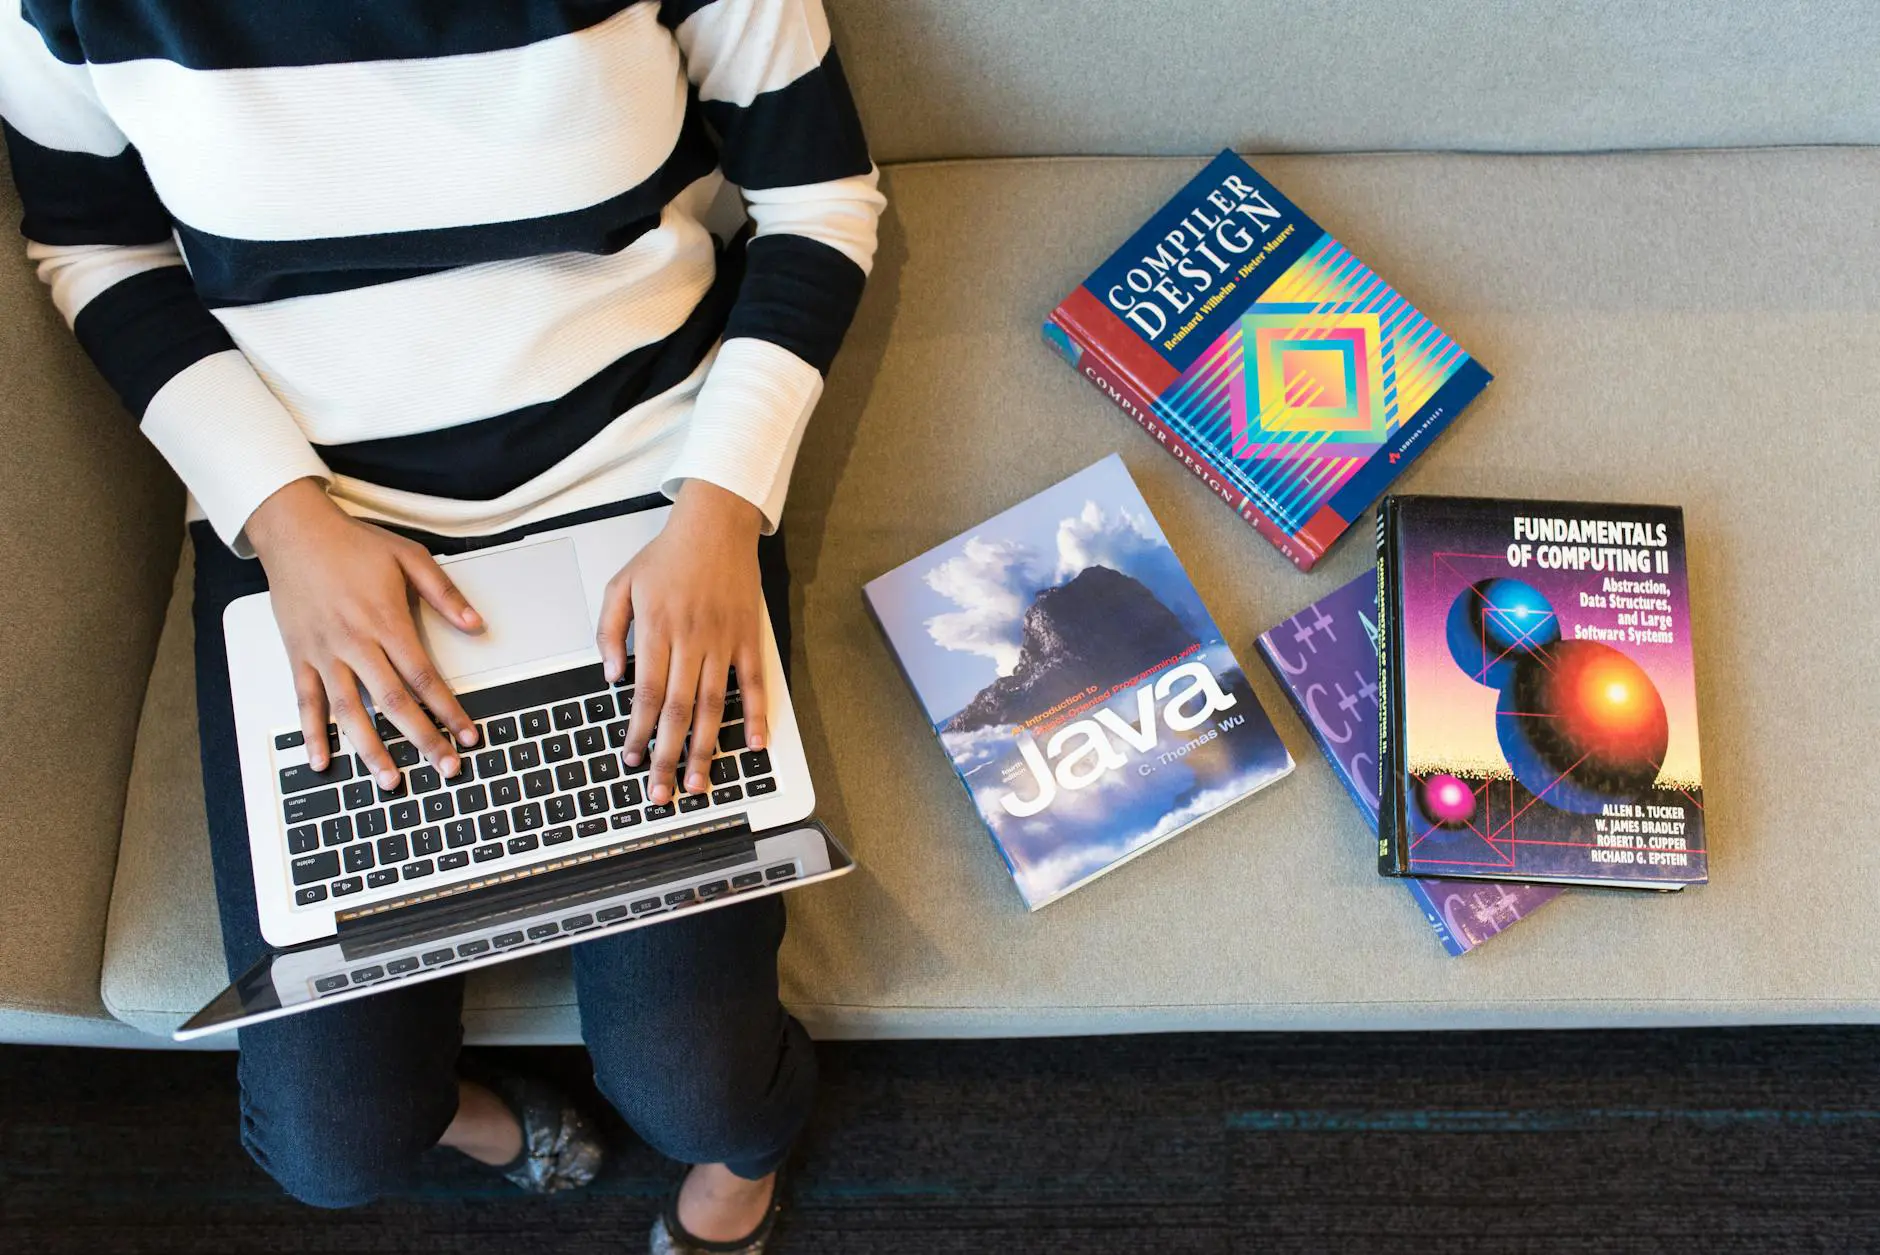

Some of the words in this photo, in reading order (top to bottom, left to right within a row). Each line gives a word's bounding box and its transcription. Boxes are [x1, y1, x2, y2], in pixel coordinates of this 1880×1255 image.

[1109, 175, 1253, 310] COMPILER
[1125, 190, 1281, 340] DESIGN
[1163, 312, 1204, 350] Reinhard
[1200, 281, 1236, 315] Wilhelm
[1239, 252, 1265, 278] Dieter
[1263, 224, 1295, 254] Maurer
[1086, 367, 1167, 443] COMPILER
[1173, 445, 1233, 502] DESIGN
[1514, 517, 1667, 547] FUNDAMENTALS
[1507, 544, 1531, 568] OF
[1537, 545, 1651, 574] COMPUTING
[1656, 551, 1669, 574] II
[1603, 577, 1670, 597] Abstraction,
[1580, 592, 1606, 608] Data
[1609, 593, 1671, 612] Structures,
[1618, 611, 1638, 625] and
[1641, 612, 1672, 630] Large
[1575, 624, 1625, 641] Software
[1628, 627, 1673, 645] Systems
[1382, 651, 1387, 666] OF
[1112, 654, 1179, 693] Programming
[1179, 643, 1201, 658] with
[596, 704, 603, 712] C
[1011, 725, 1026, 736] An
[1026, 692, 1084, 726] Introduction
[1086, 685, 1098, 694] to
[565, 712, 571, 720] V
[532, 719, 538, 727] B
[499, 726, 506, 735] N
[619, 729, 625, 737] D
[587, 737, 592, 745] F
[999, 661, 1237, 817] Java
[553, 744, 560, 752] G
[1138, 763, 1156, 776] C.
[1158, 727, 1217, 765] Thomas
[1218, 714, 1244, 733] Wu
[520, 752, 528, 760] H
[489, 759, 493, 767] J
[569, 772, 574, 780] T
[536, 779, 541, 787] Y
[501, 787, 509, 795] U
[589, 792, 594, 800] 5
[625, 794, 630, 802] $
[434, 802, 442, 810] O
[556, 800, 562, 808] 6
[590, 802, 598, 810] %
[402, 810, 408, 819] P
[524, 808, 529, 816] 7
[1602, 804, 1632, 817] ALLEN
[1635, 805, 1645, 817] B.
[1647, 805, 1684, 819] TUCKER
[490, 816, 495, 824] 8
[1595, 819, 1608, 831] W.
[1610, 820, 1639, 835] JAMES
[1642, 821, 1685, 834] BRADLEY
[422, 832, 428, 840] 0
[1597, 835, 1634, 848] ROBERT
[1636, 837, 1646, 848] D.
[1649, 837, 1686, 850] CUPPER
[297, 858, 315, 866] delete
[1591, 850, 1634, 863] RICHARD
[1636, 852, 1646, 864] G.
[1649, 852, 1687, 866] EPSTEIN
